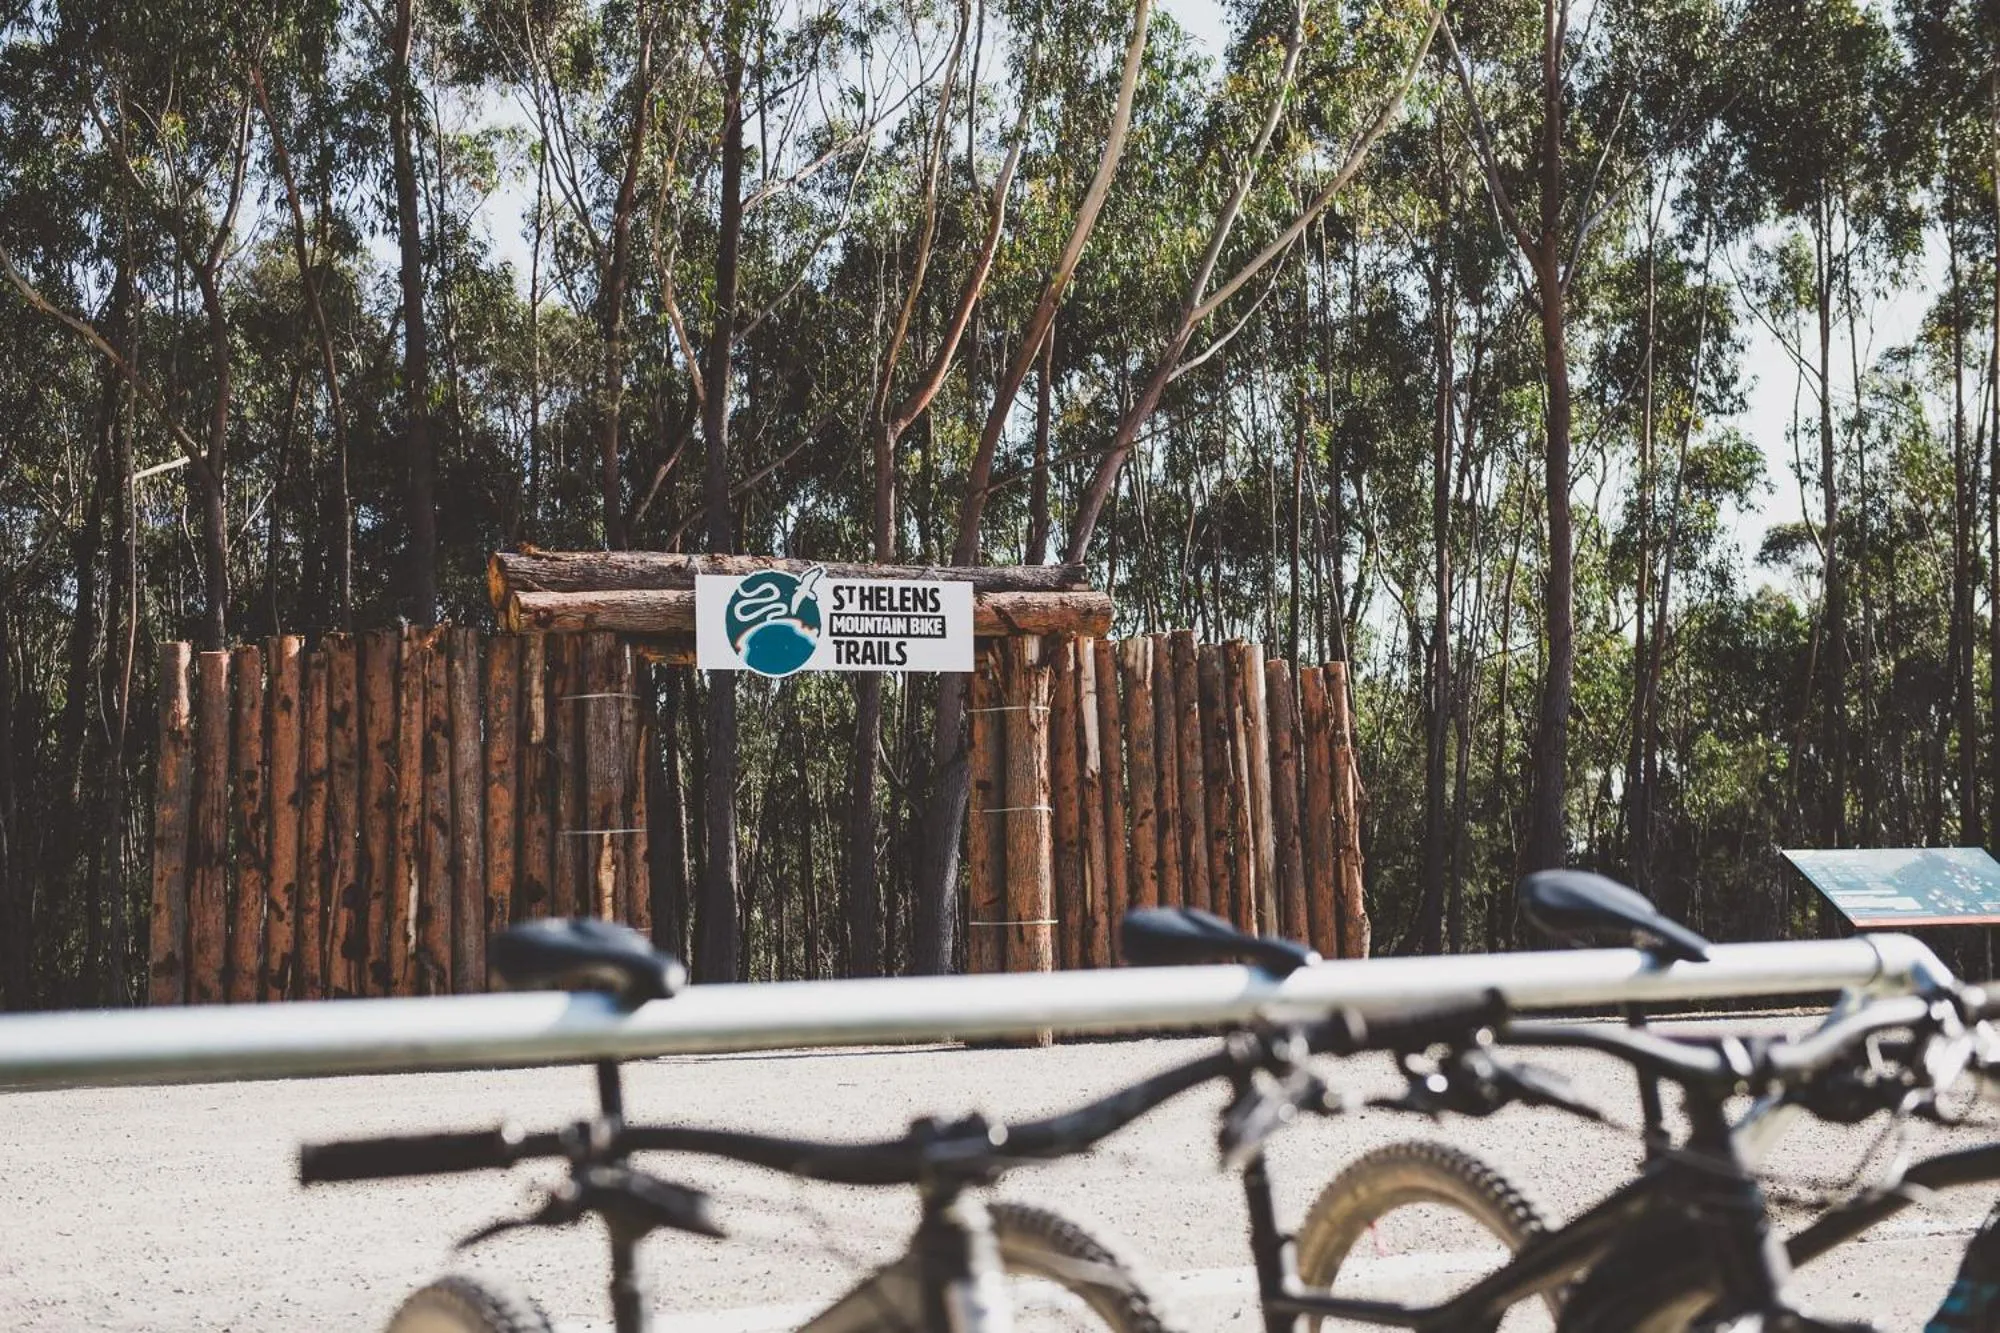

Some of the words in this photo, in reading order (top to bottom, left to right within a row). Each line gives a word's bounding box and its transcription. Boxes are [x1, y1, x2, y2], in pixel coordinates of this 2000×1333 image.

[859, 586, 941, 612] HELENS
[832, 616, 908, 635] MOUNTAIN
[910, 618, 943, 635] BIKE
[833, 639, 908, 666] TRAILS
